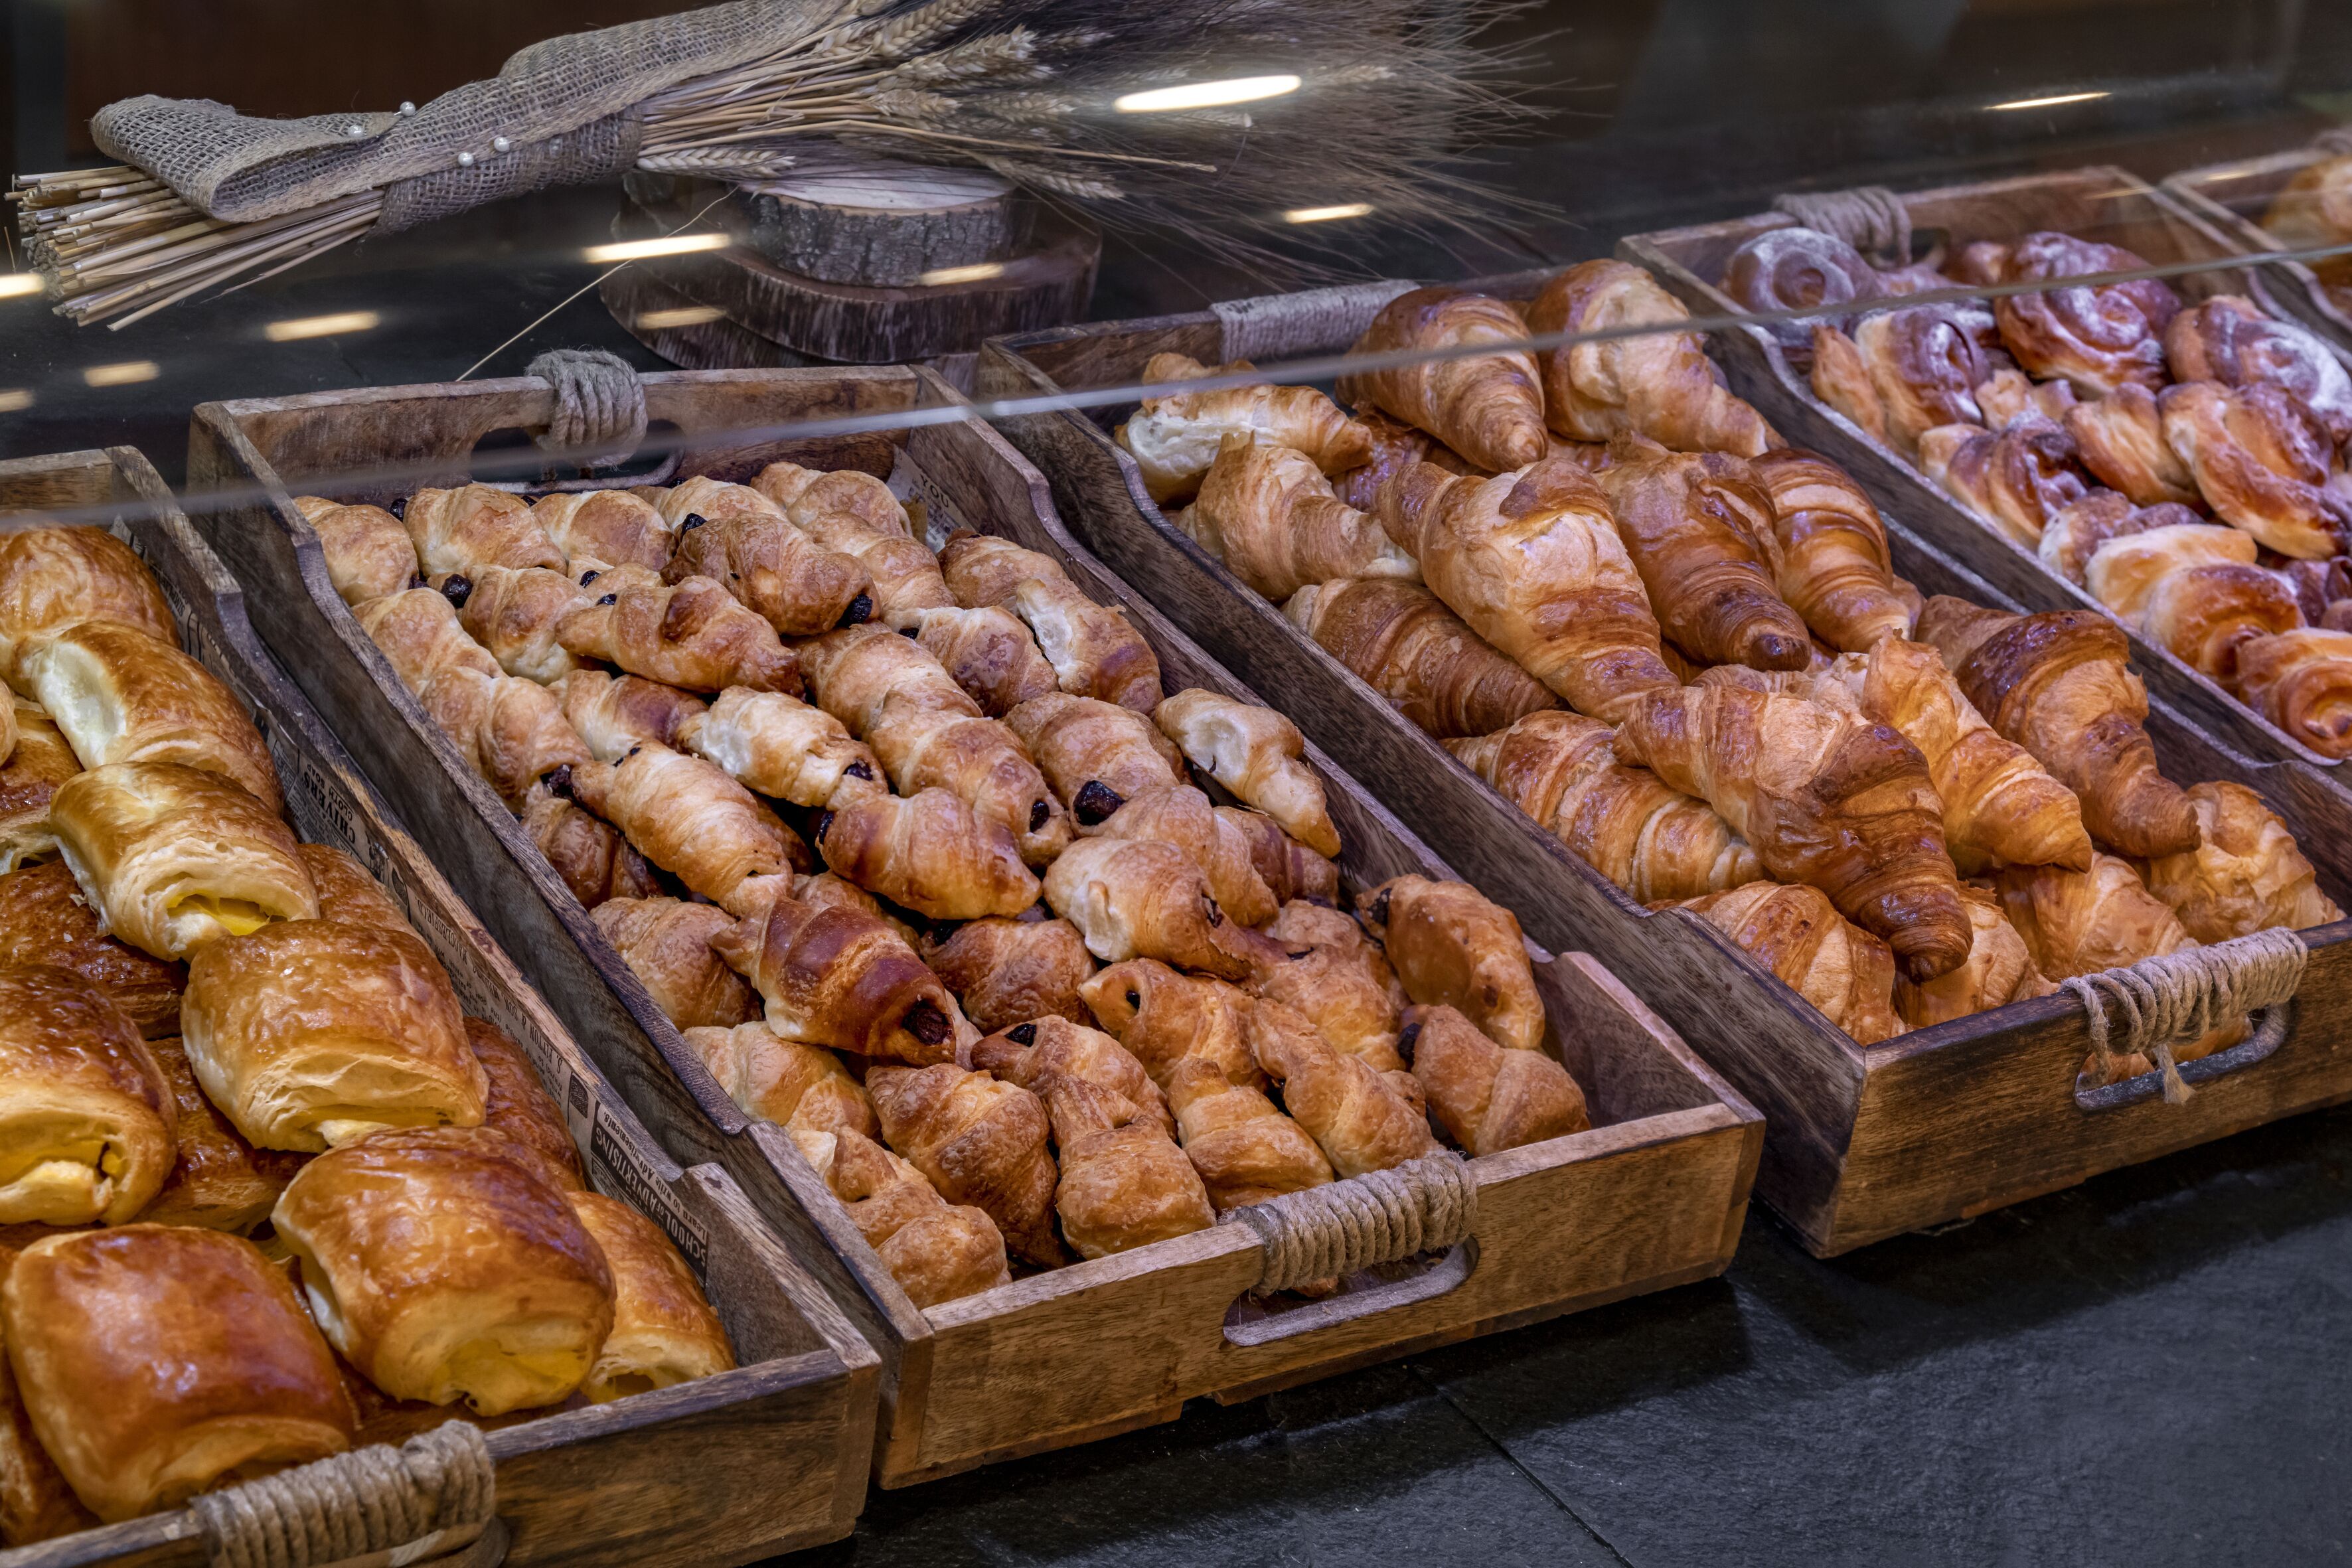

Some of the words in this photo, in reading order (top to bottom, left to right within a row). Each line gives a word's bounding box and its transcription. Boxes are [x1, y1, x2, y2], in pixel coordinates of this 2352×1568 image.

[920, 473, 950, 509] YOU
[306, 763, 325, 789] SOAP
[328, 787, 353, 823] CLOTH
[521, 1012, 526, 1030] &
[529, 1022, 552, 1064] FITTON
[556, 1054, 562, 1075] S.
[595, 1126, 657, 1211] ADVERTISING
[655, 1175, 670, 1202] write
[655, 1200, 663, 1215] OF
[673, 1197, 680, 1214] to
[665, 1208, 706, 1268] SCHOOL
[682, 1209, 706, 1241] Learn
